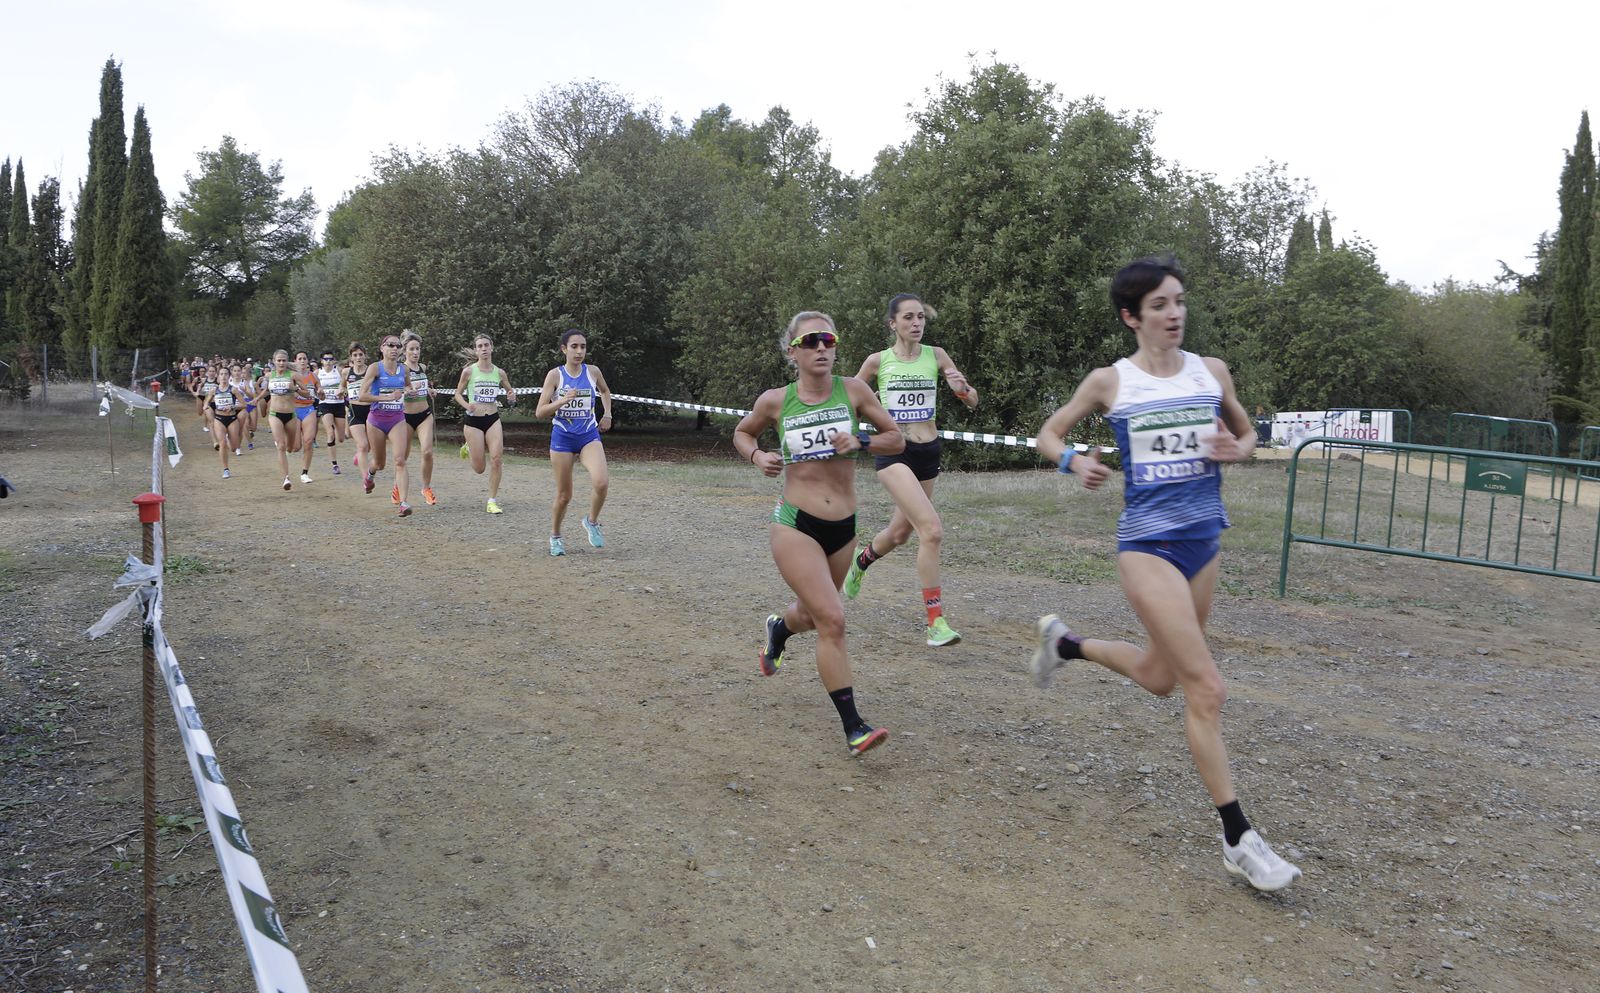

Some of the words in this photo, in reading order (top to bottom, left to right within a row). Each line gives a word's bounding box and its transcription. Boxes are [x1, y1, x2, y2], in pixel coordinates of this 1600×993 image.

[898, 393, 924, 406] 490
[820, 412, 828, 421] DE
[893, 410, 928, 420] Joma
[1151, 431, 1200, 455] 424
[1142, 460, 1204, 481] Joma
